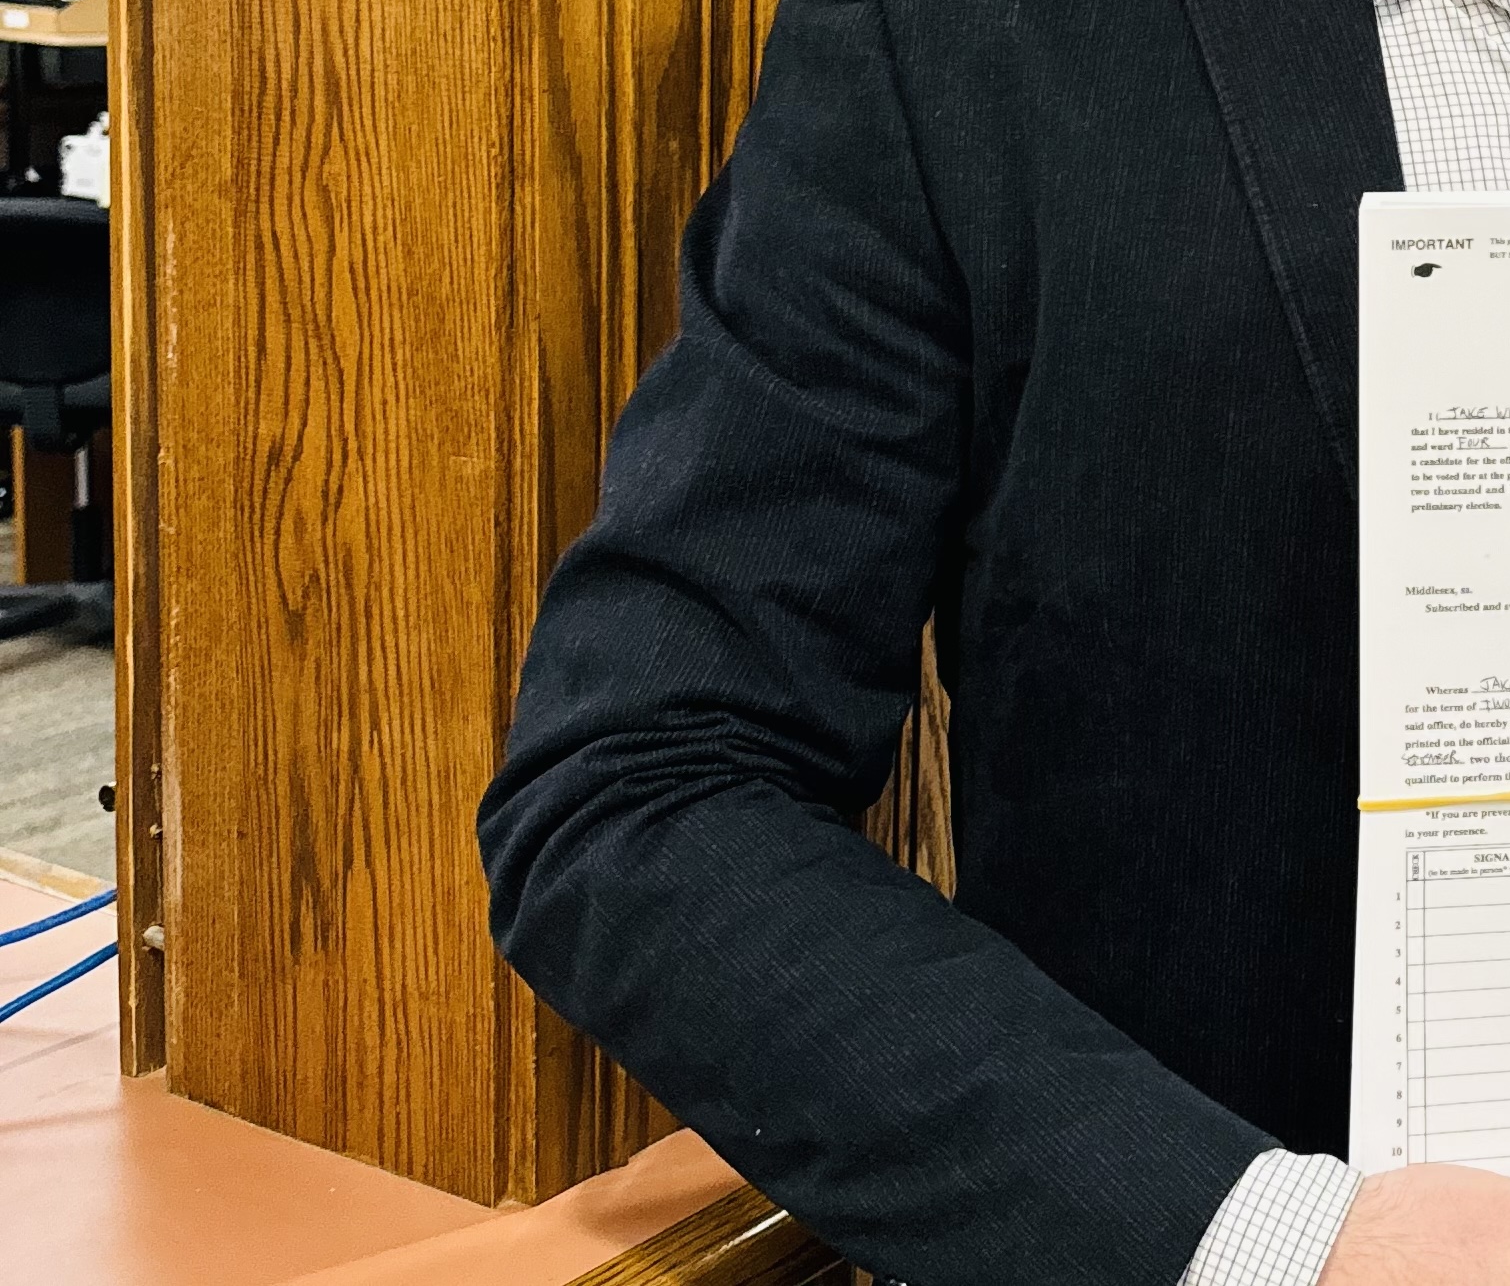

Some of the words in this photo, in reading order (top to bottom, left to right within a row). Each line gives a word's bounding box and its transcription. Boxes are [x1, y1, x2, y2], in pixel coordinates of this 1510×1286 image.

[1392, 238, 1474, 250] IMPORTANT
[1446, 406, 1489, 419] JAKE
[1455, 436, 1490, 449] FOUR
[1406, 586, 1457, 595] Middlesex,
[1426, 603, 1479, 613] Subscribed
[1483, 602, 1501, 610] and
[1405, 705, 1419, 713] for
[1423, 704, 1437, 712] the
[1466, 702, 1477, 711] of
[1405, 722, 1424, 730] said
[1427, 721, 1456, 730] office,
[1459, 720, 1471, 729] do
[1475, 719, 1507, 729] hereby
[1405, 775, 1447, 786] qualified
[1462, 773, 1502, 784] perform
[1405, 830, 1414, 838] in
[1417, 831, 1439, 839] your
[1443, 829, 1487, 838] presence.
